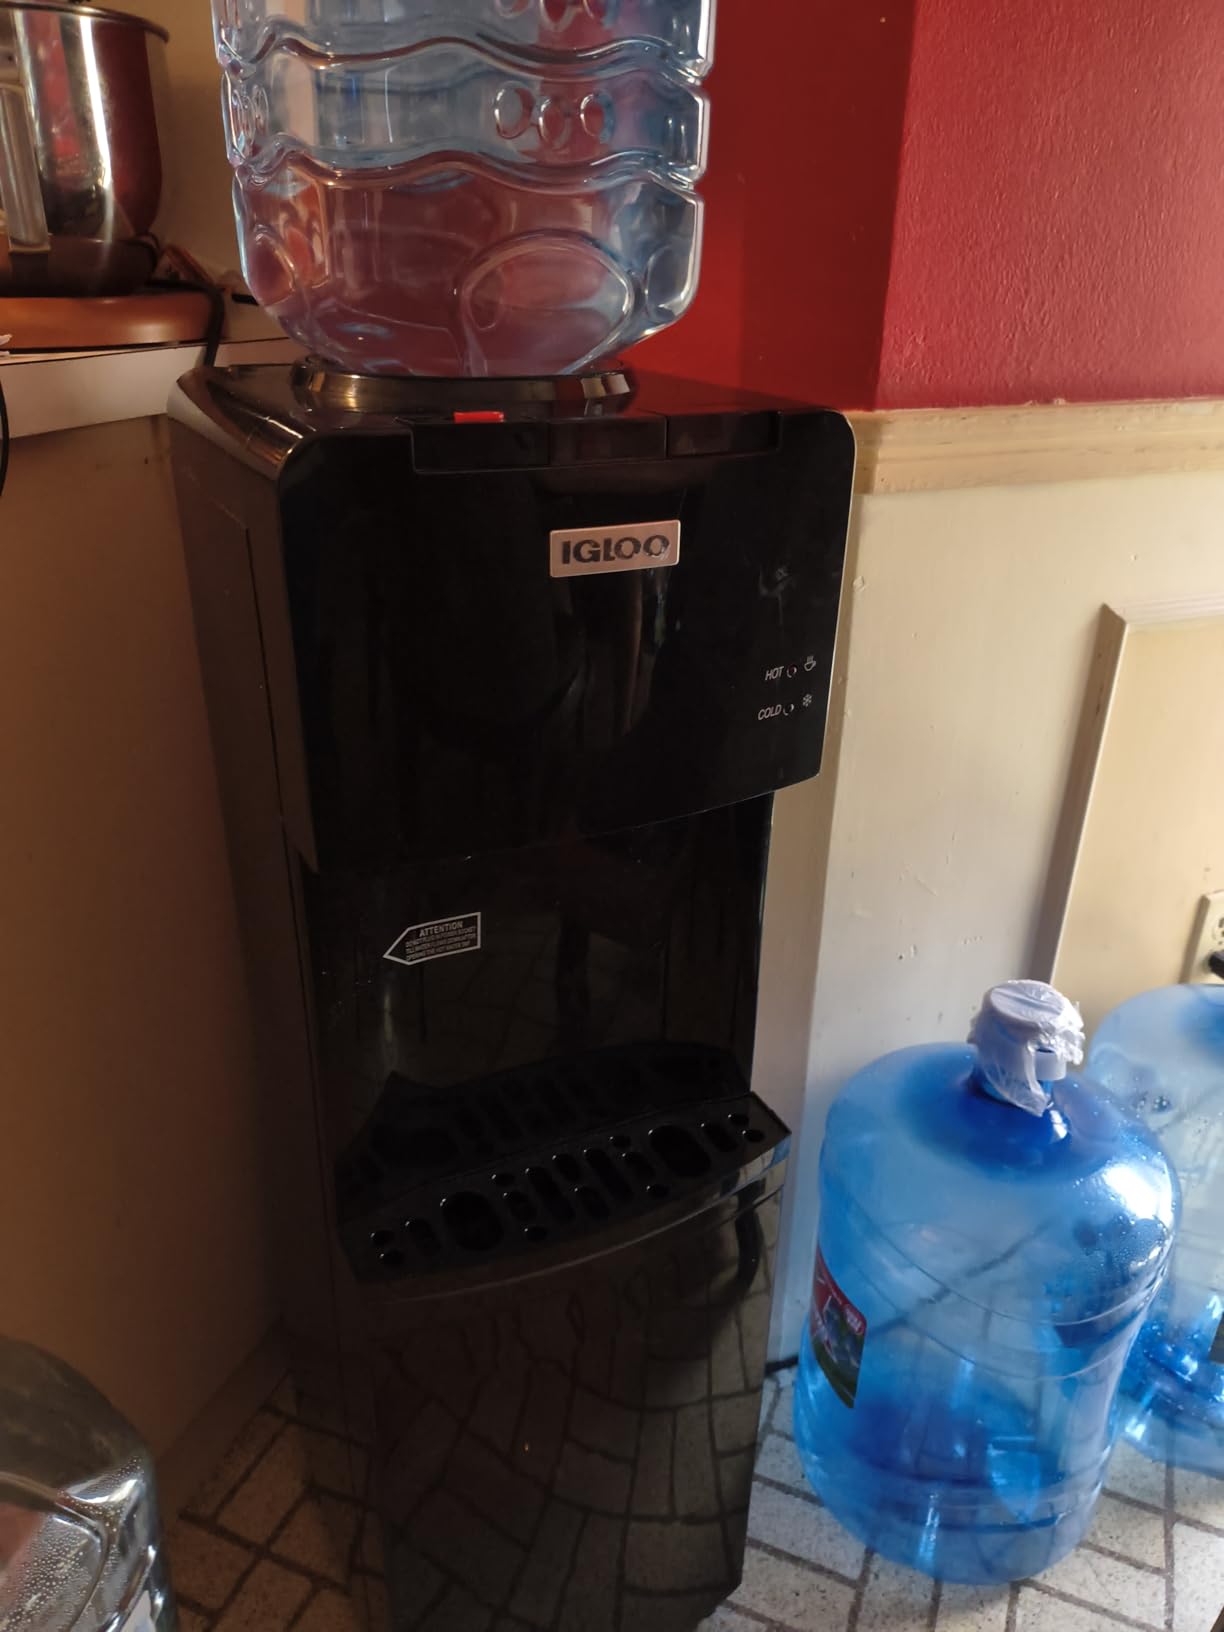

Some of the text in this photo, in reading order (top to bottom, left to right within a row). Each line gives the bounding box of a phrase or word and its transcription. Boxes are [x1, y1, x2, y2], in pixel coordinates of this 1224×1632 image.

[562, 534, 670, 565] IGLOO
[764, 665, 784, 680] HOT
[757, 704, 782, 720] COLD
[419, 920, 465, 937] ATTENTION
